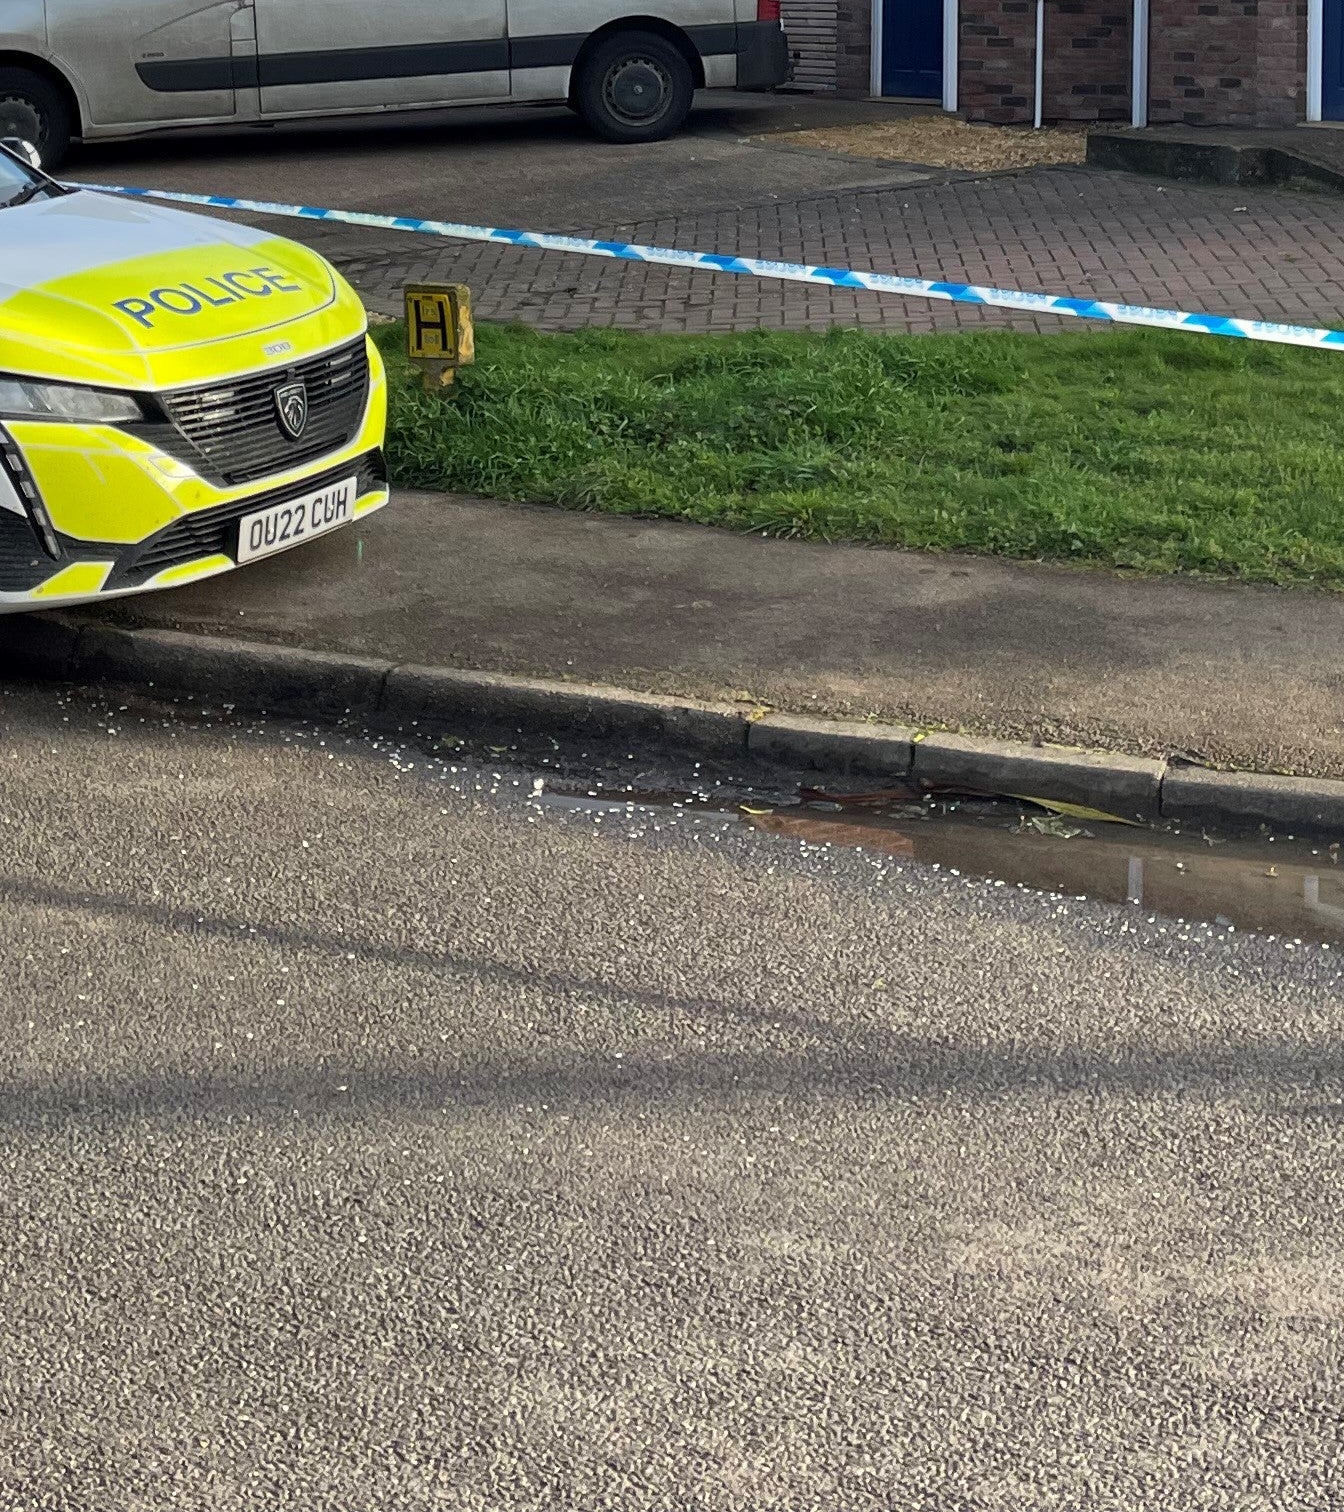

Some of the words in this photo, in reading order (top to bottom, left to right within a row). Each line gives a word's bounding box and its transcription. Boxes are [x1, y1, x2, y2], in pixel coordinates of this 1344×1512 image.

[112, 266, 303, 328] POLICE
[413, 299, 449, 351] H
[249, 504, 306, 551] OU22
[311, 486, 348, 529] CUH
